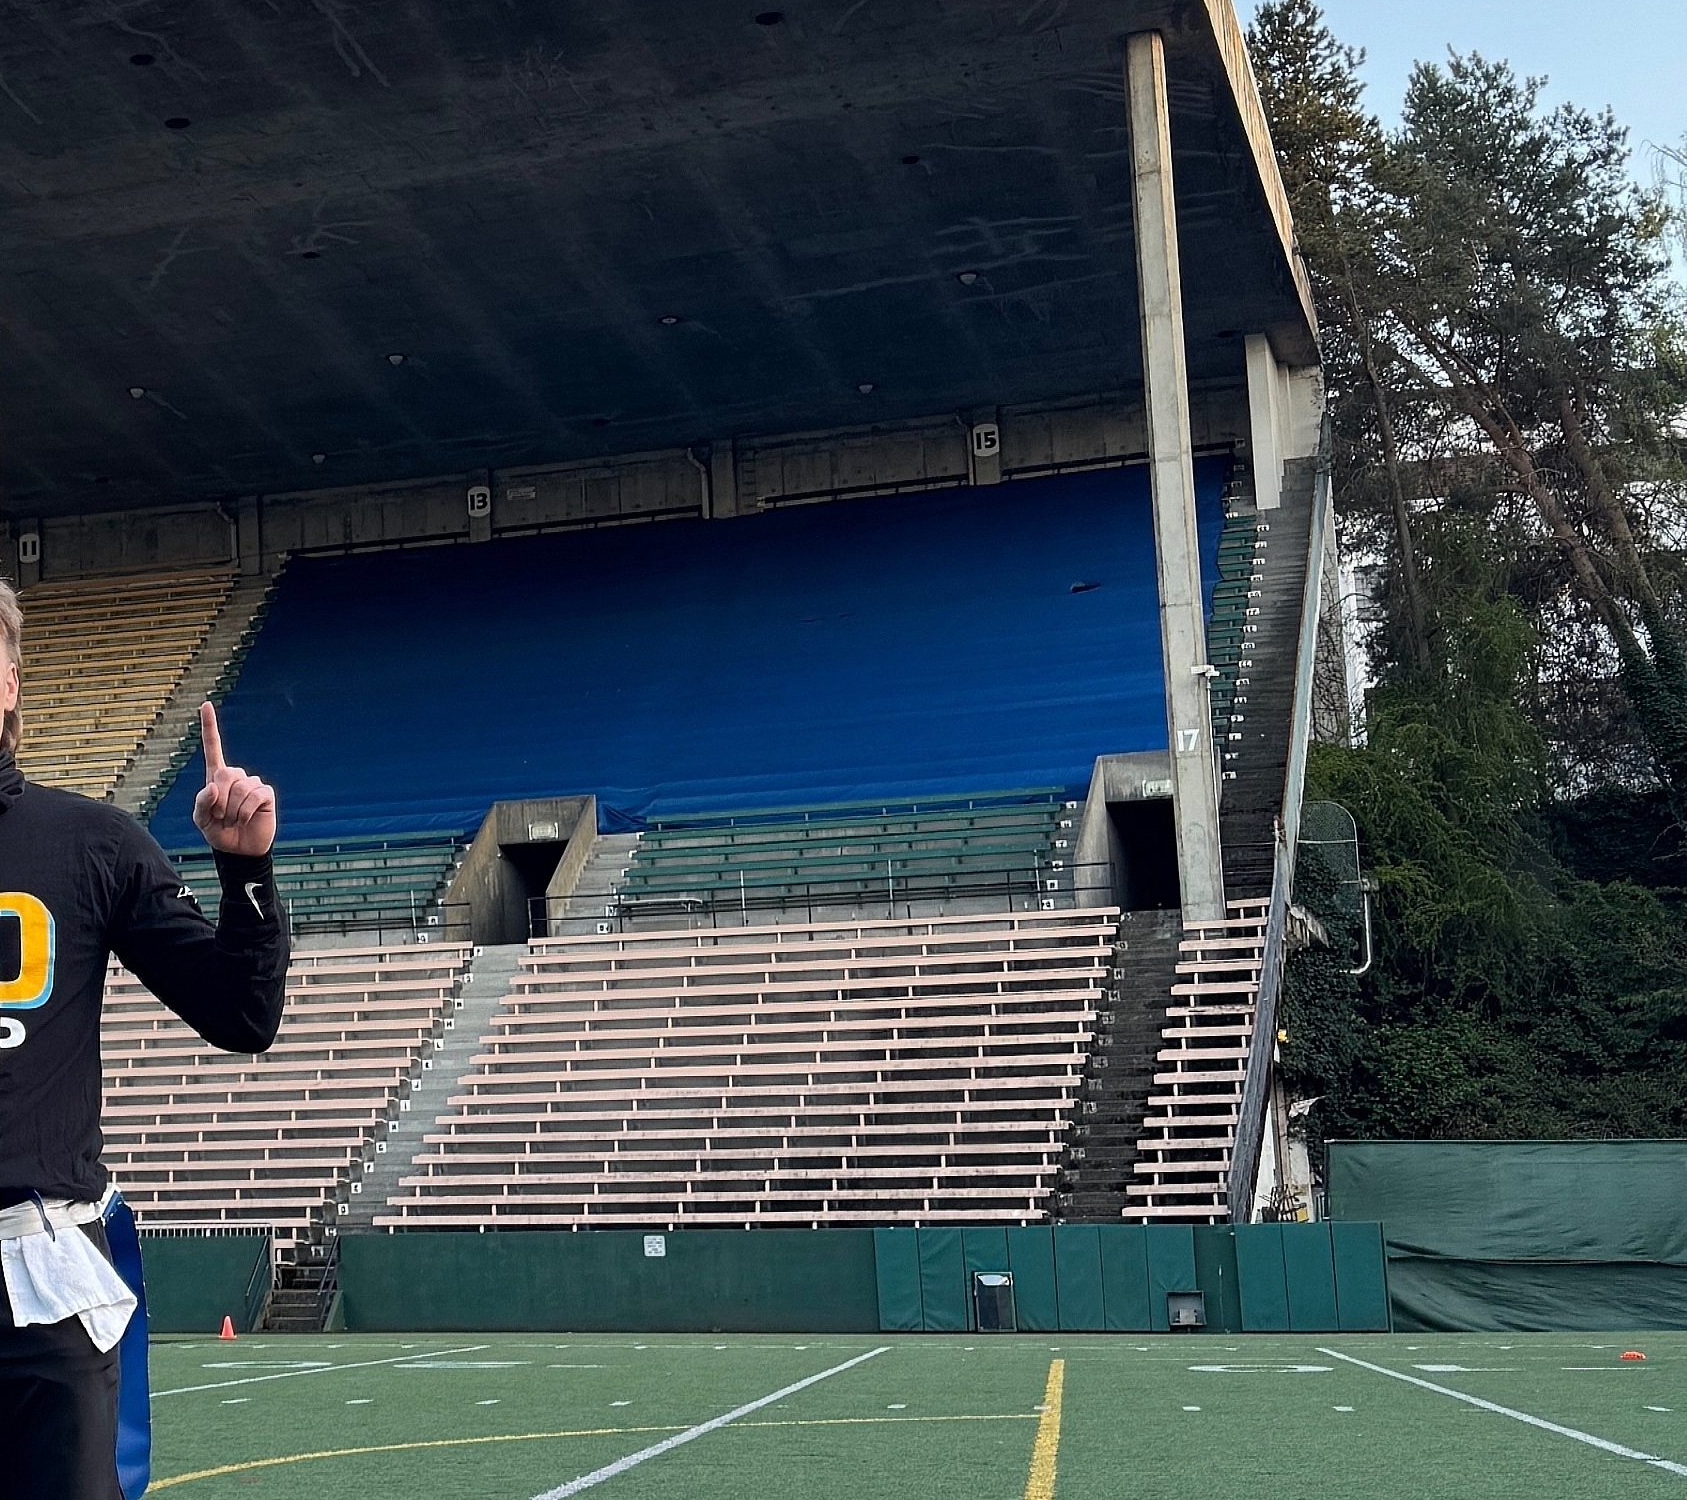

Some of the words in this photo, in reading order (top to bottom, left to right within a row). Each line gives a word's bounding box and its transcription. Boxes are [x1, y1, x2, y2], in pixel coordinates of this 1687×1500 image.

[976, 431, 997, 451] 15
[469, 492, 488, 511] 13
[21, 540, 37, 556] 11
[1177, 728, 1200, 752] 17
